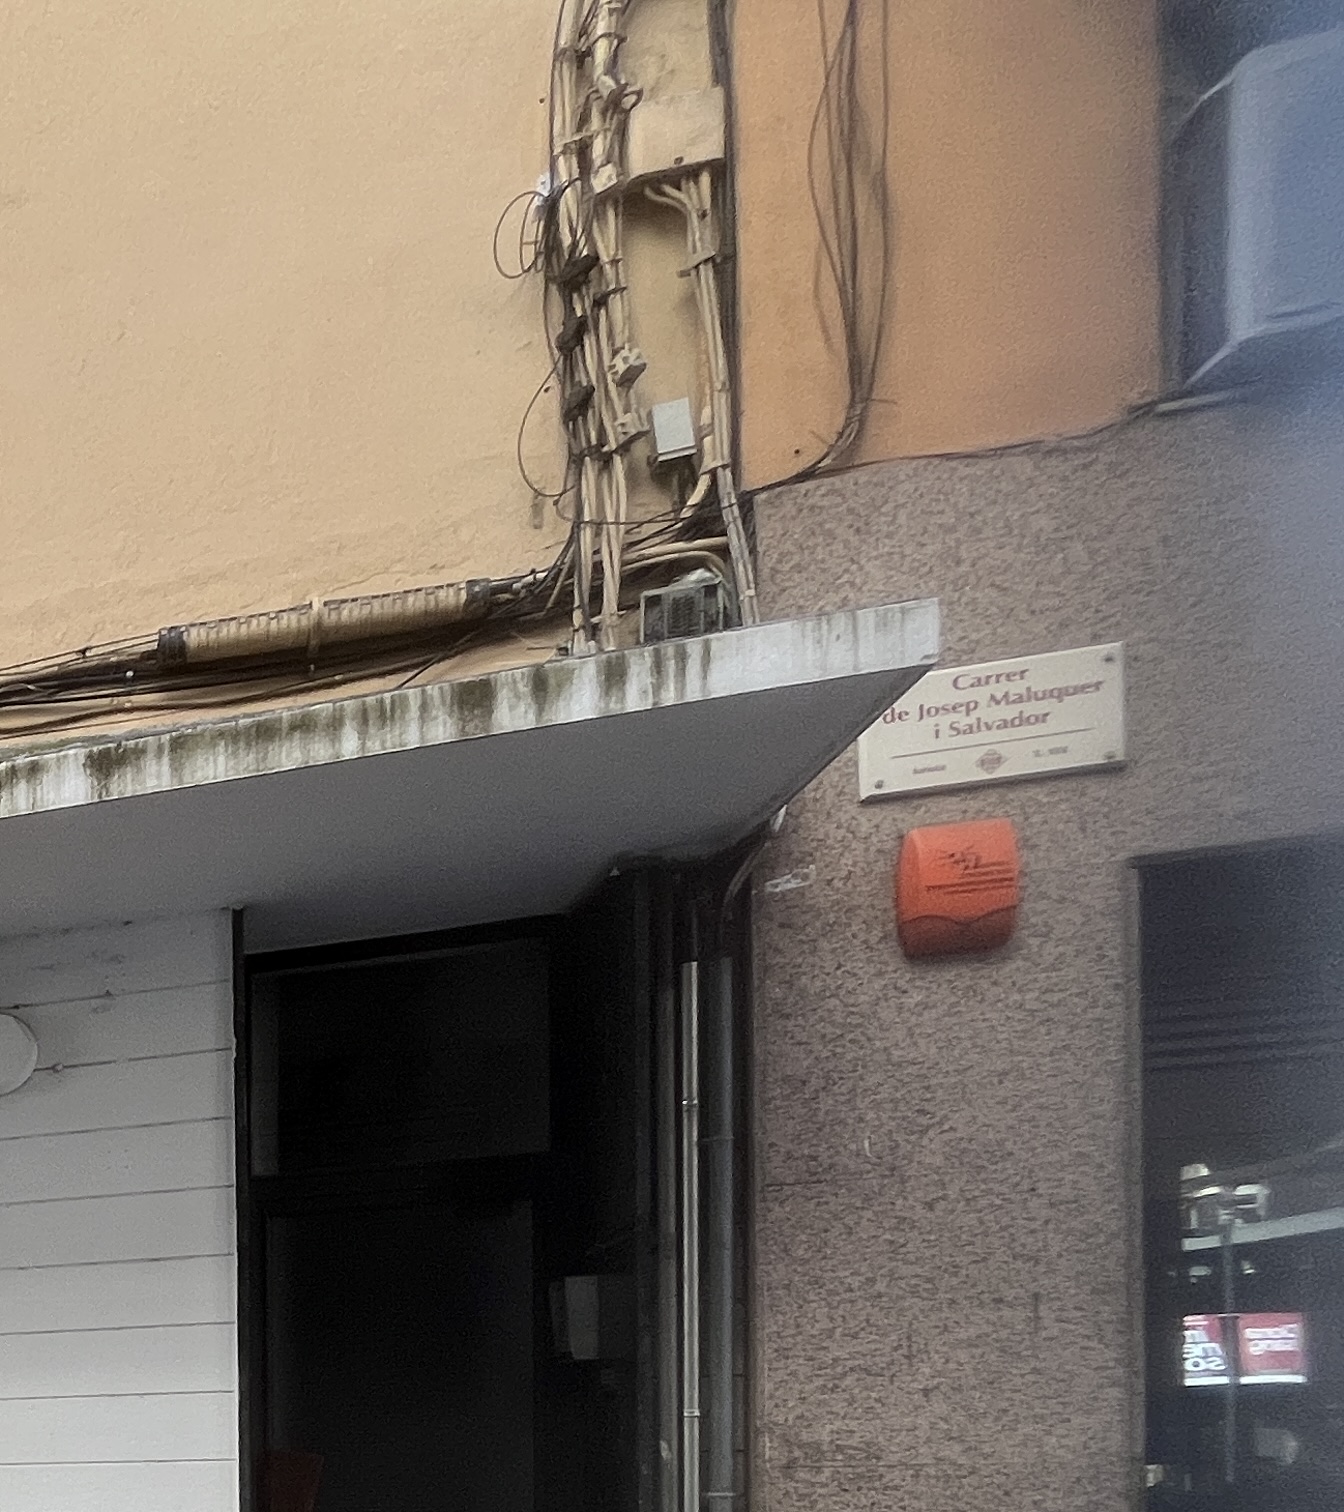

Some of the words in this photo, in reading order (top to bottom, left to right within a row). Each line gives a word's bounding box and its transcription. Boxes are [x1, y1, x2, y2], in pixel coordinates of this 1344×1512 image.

[952, 668, 1030, 691] Carrer
[882, 706, 910, 724] de
[918, 698, 979, 722] Josep
[989, 680, 1106, 704] Maluquer
[934, 723, 941, 739] i
[949, 710, 1051, 737] Salvador
